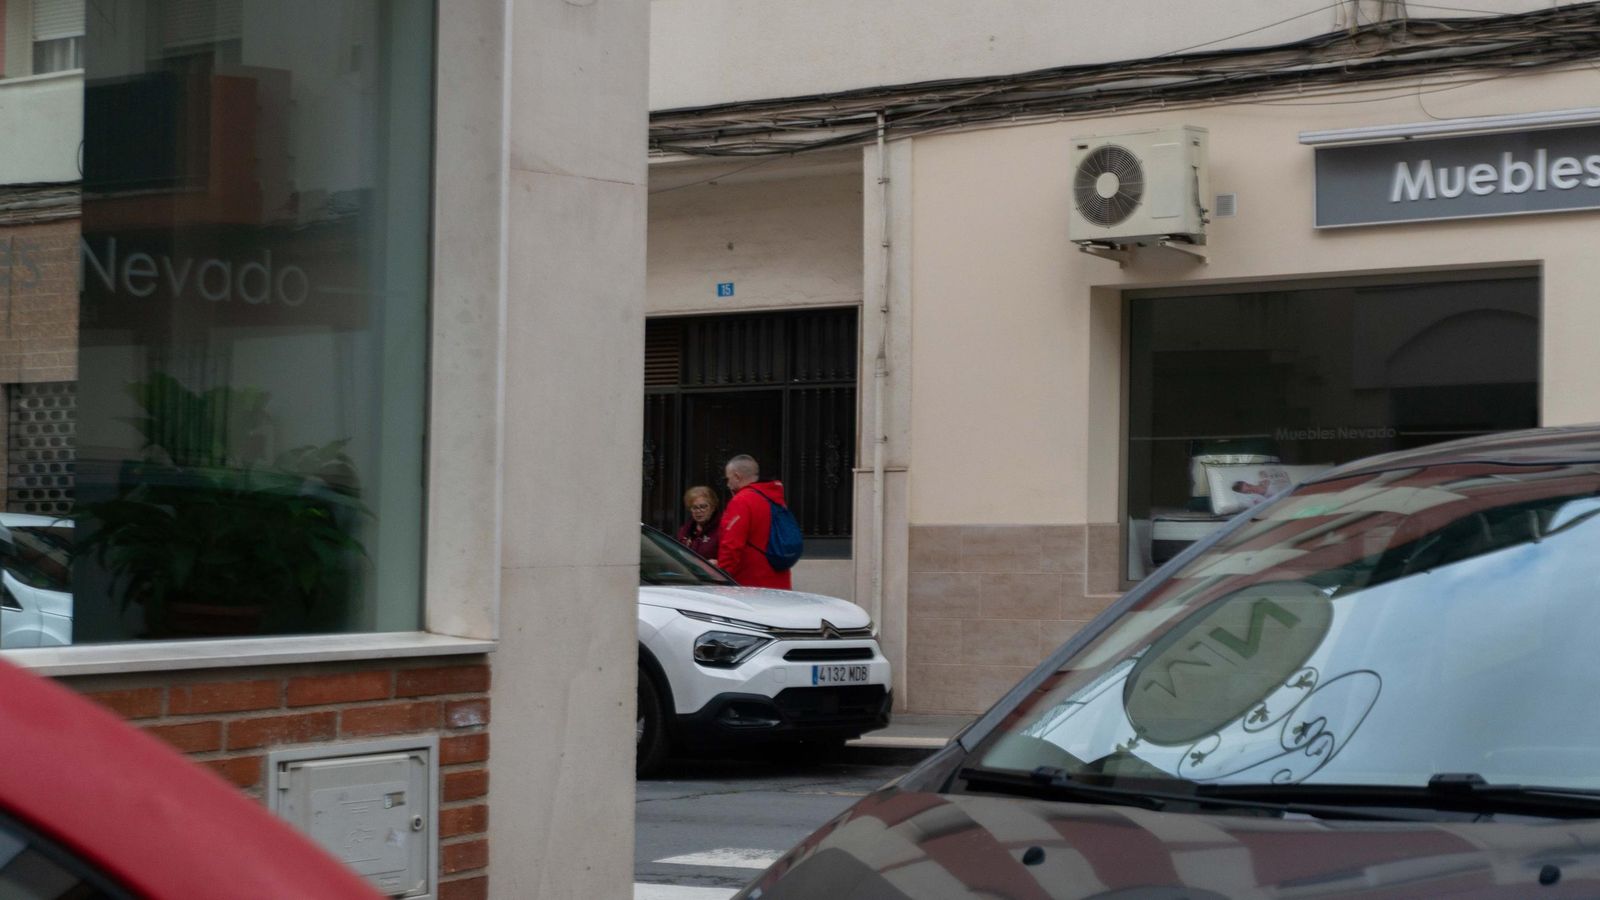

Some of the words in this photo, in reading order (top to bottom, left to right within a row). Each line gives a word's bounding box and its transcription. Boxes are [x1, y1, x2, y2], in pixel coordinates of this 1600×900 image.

[1391, 148, 1600, 203] Muebles
[79, 234, 309, 307] Nevado
[1275, 426, 1337, 440] Muebles
[1338, 424, 1396, 439] Nevado
[820, 666, 846, 682] 4132
[848, 666, 868, 681] MDB
